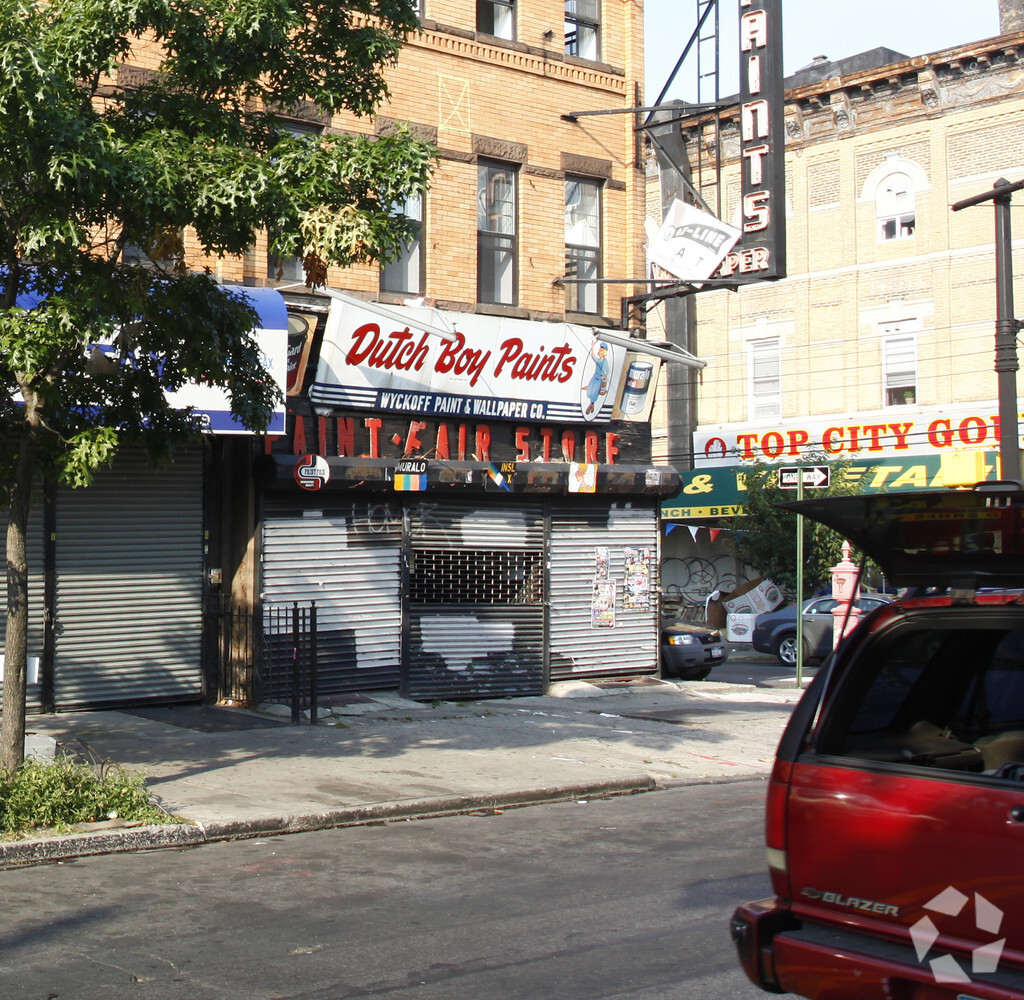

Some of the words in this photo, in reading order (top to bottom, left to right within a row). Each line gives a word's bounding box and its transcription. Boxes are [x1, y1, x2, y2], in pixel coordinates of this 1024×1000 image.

[345, 323, 430, 371] Dutch
[434, 331, 492, 388] Boy
[493, 337, 577, 384] Paints
[380, 392, 432, 411] WYCKOFF
[433, 396, 464, 414] PAINT
[464, 398, 472, 414] &
[473, 399, 529, 418] WALLPAPER
[529, 403, 546, 420] CO.
[736, 429, 809, 460] TOP
[821, 421, 914, 455] CITY
[683, 474, 714, 495] &
[805, 472, 822, 481] WAY
[821, 891, 902, 918] BLAZER
